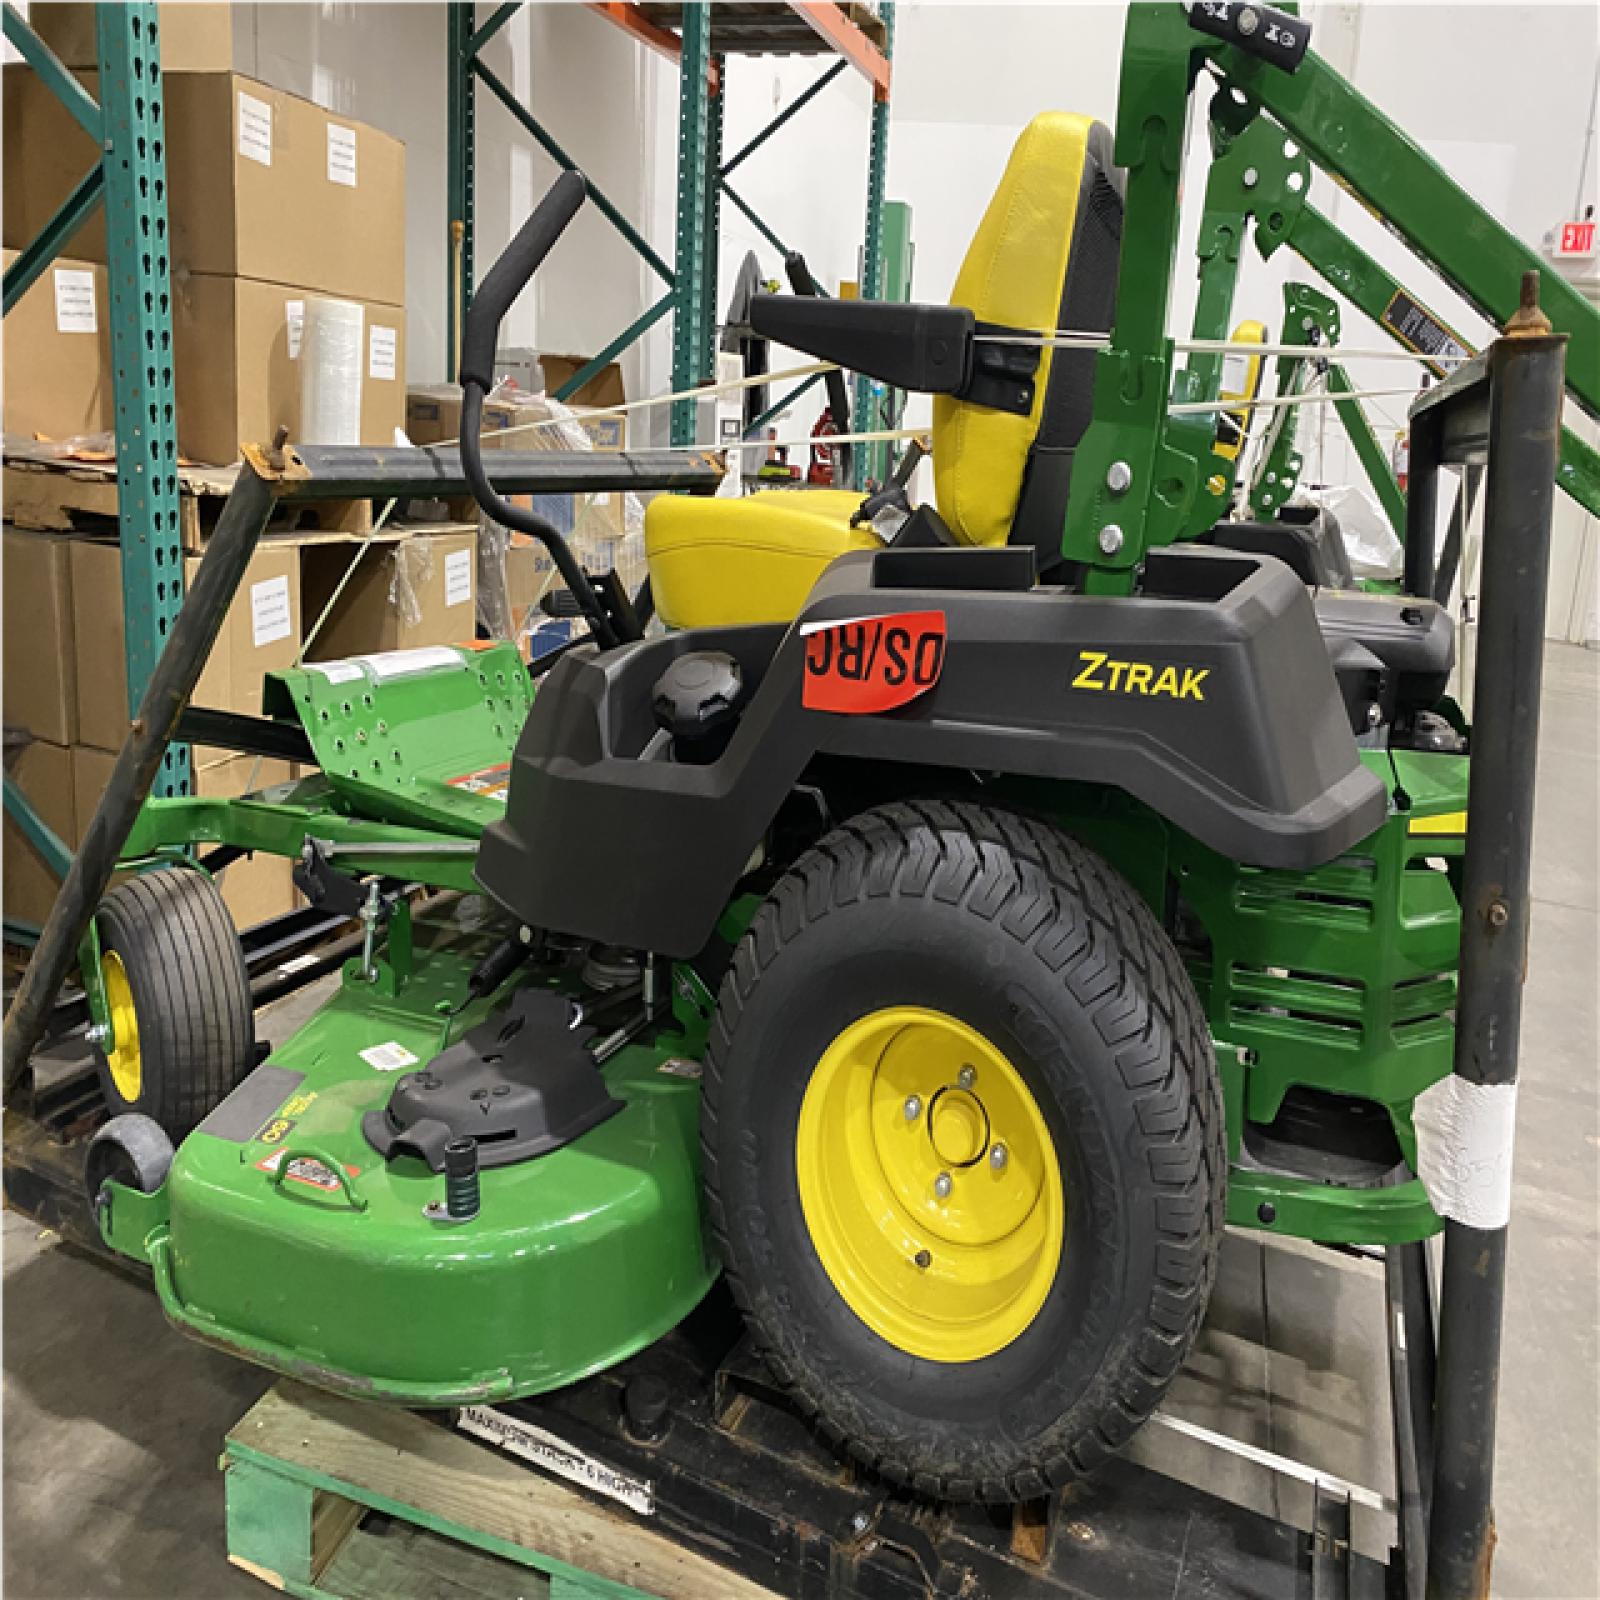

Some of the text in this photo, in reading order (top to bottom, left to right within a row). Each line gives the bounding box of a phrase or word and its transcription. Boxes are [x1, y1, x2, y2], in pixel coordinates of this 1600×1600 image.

[1562, 224, 1595, 251] EXIT
[807, 622, 944, 686] DS/RC
[1072, 650, 1210, 701] ZTRAK
